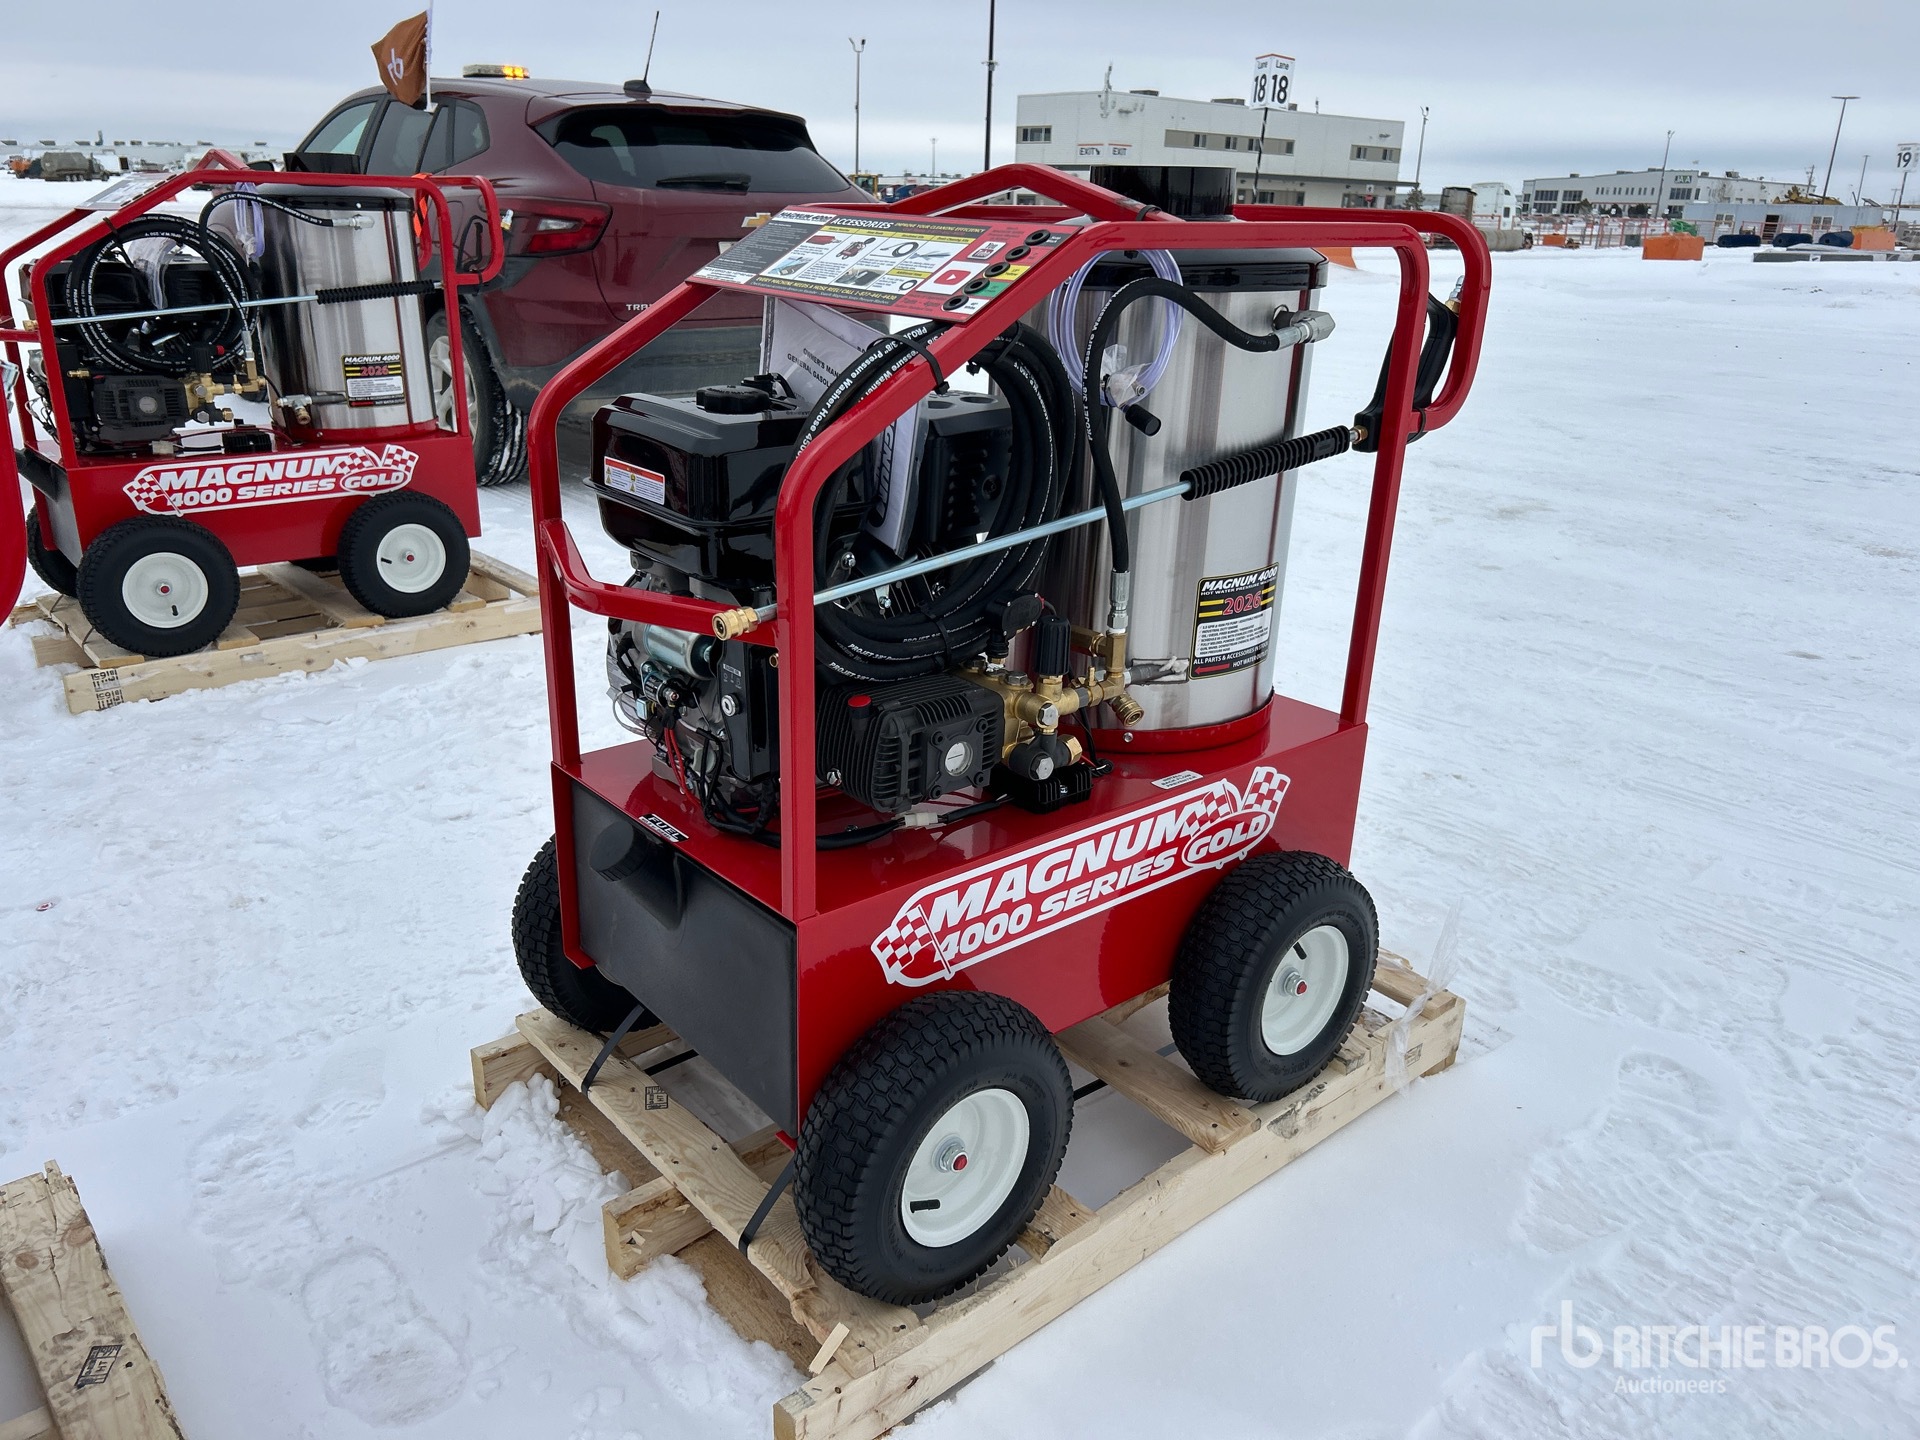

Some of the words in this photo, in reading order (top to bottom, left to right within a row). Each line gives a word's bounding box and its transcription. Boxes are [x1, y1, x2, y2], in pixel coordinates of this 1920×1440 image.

[1275, 60, 1290, 70] Lane
[1253, 73, 1267, 103] 18
[1271, 74, 1289, 104] 18
[1896, 151, 1912, 168] 19
[830, 217, 894, 229] ACCESSORIES
[1092, 298, 1112, 331] Washer
[787, 353, 813, 375] GENERAL
[803, 348, 826, 369] OWNER'S
[850, 350, 884, 379] Pressure
[1083, 333, 1095, 379] Pressure
[360, 365, 389, 376] 2026
[826, 378, 853, 408] Washer
[809, 407, 829, 432] Hose
[1082, 405, 1093, 441] PROJET
[158, 454, 351, 490] MAGNUM
[343, 473, 406, 489] GOLD
[167, 488, 233, 508] 4000
[236, 478, 336, 500] SERIES
[1201, 575, 1257, 592] MAGNUM
[1258, 566, 1278, 581] 4000
[1236, 583, 1260, 592] PRESSURE
[1223, 591, 1262, 616] 2026
[847, 643, 875, 657] PROJET
[1204, 655, 1222, 663] PARTS
[1226, 647, 1255, 660] ACCESSORIES
[1243, 657, 1257, 665] WATER
[829, 661, 857, 678] PROJET
[647, 816, 680, 840] FUEL
[1187, 815, 1266, 860] GOLD
[927, 802, 1203, 932] MAGNUM
[933, 903, 1033, 963] 4000
[1036, 846, 1178, 923] SERIES
